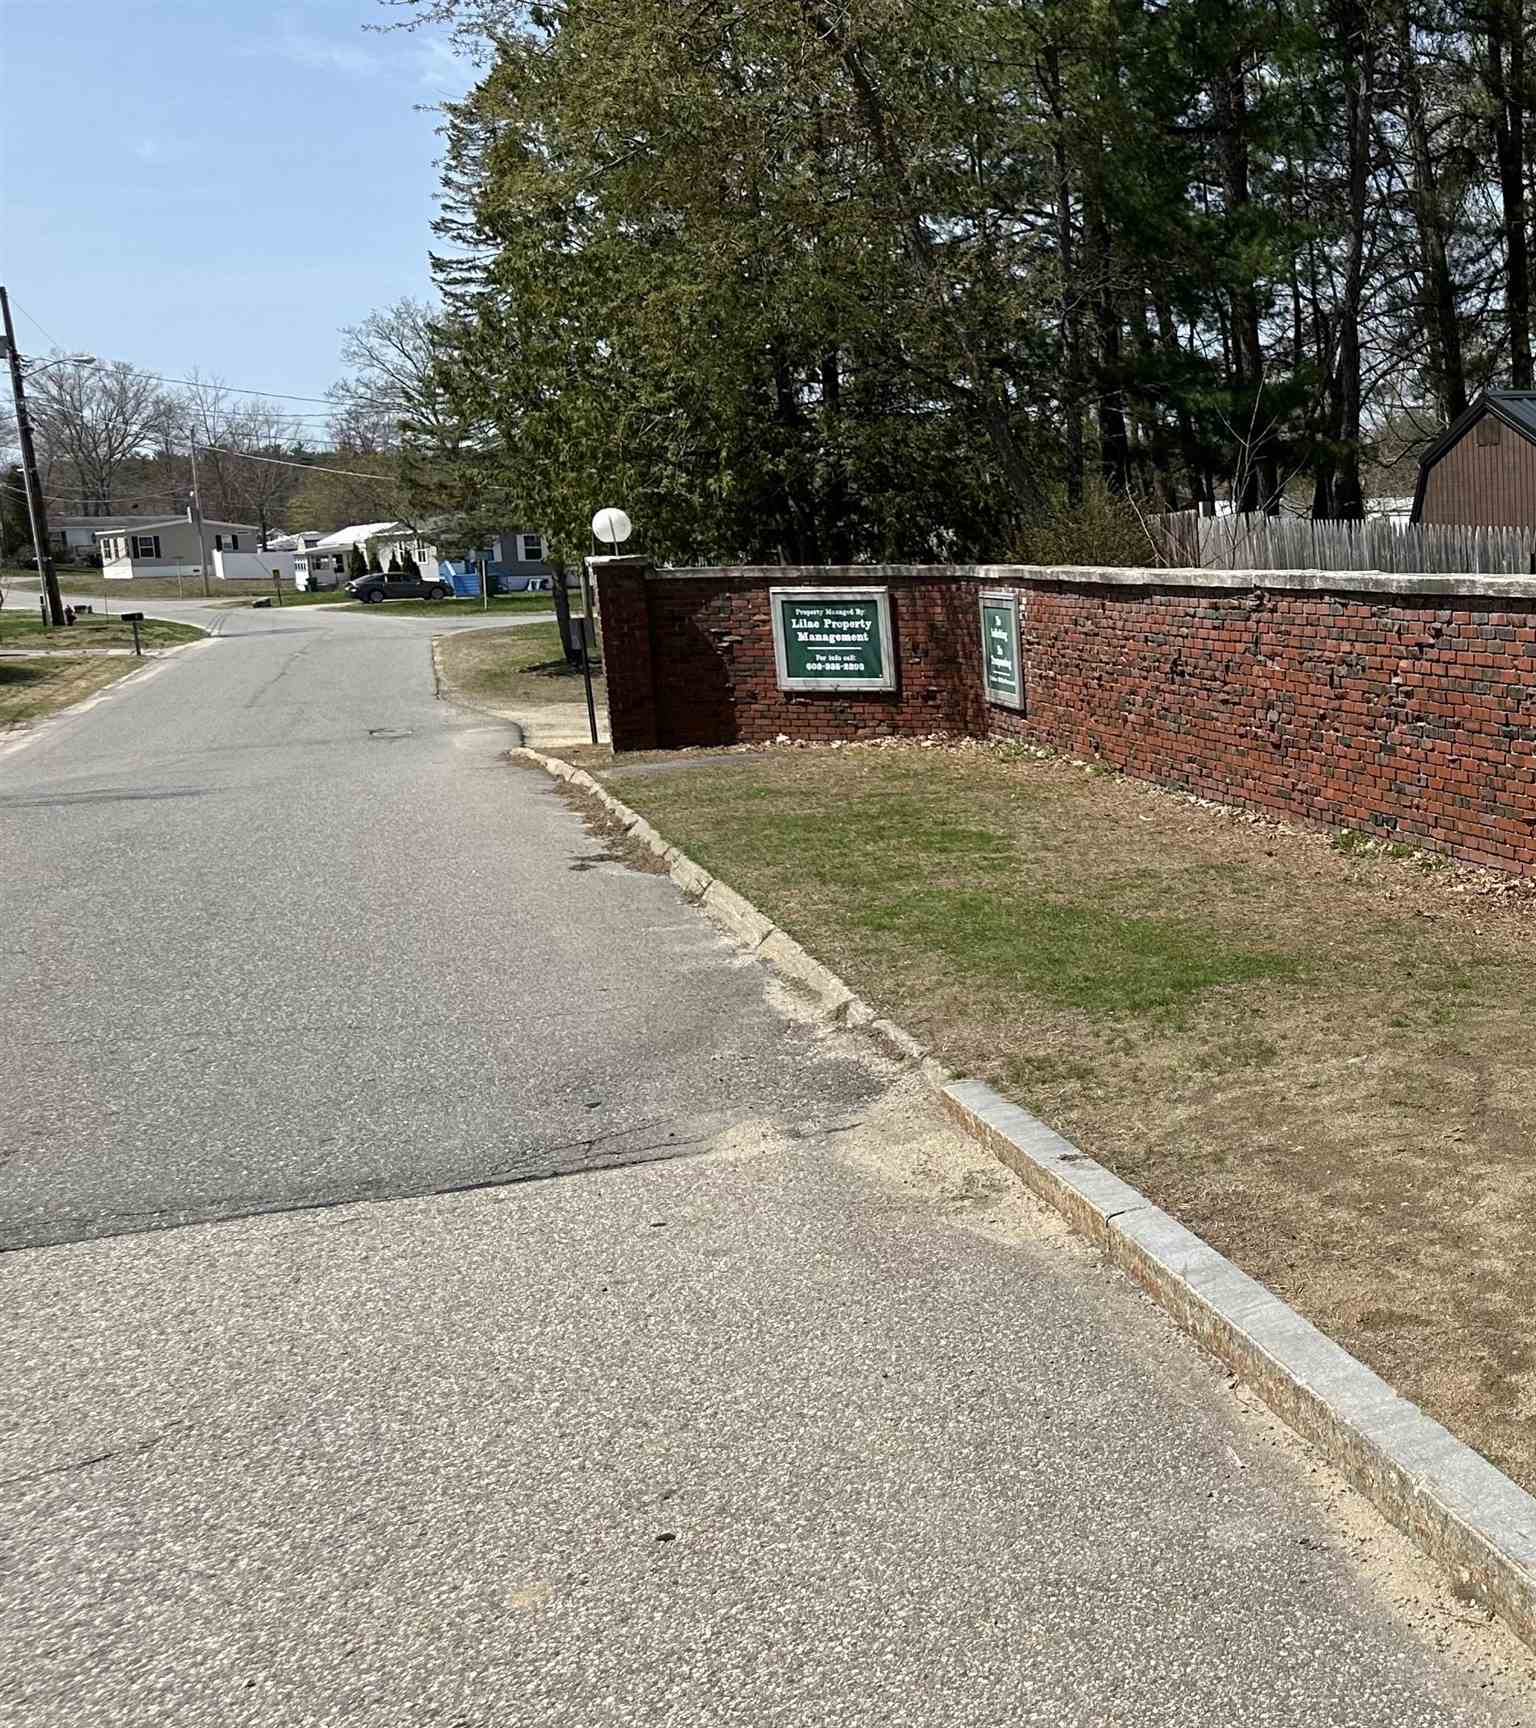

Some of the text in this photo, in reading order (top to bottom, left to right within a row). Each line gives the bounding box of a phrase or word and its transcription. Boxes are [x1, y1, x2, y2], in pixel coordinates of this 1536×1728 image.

[791, 618, 873, 631] Lilac Property
[797, 631, 870, 644] Management
